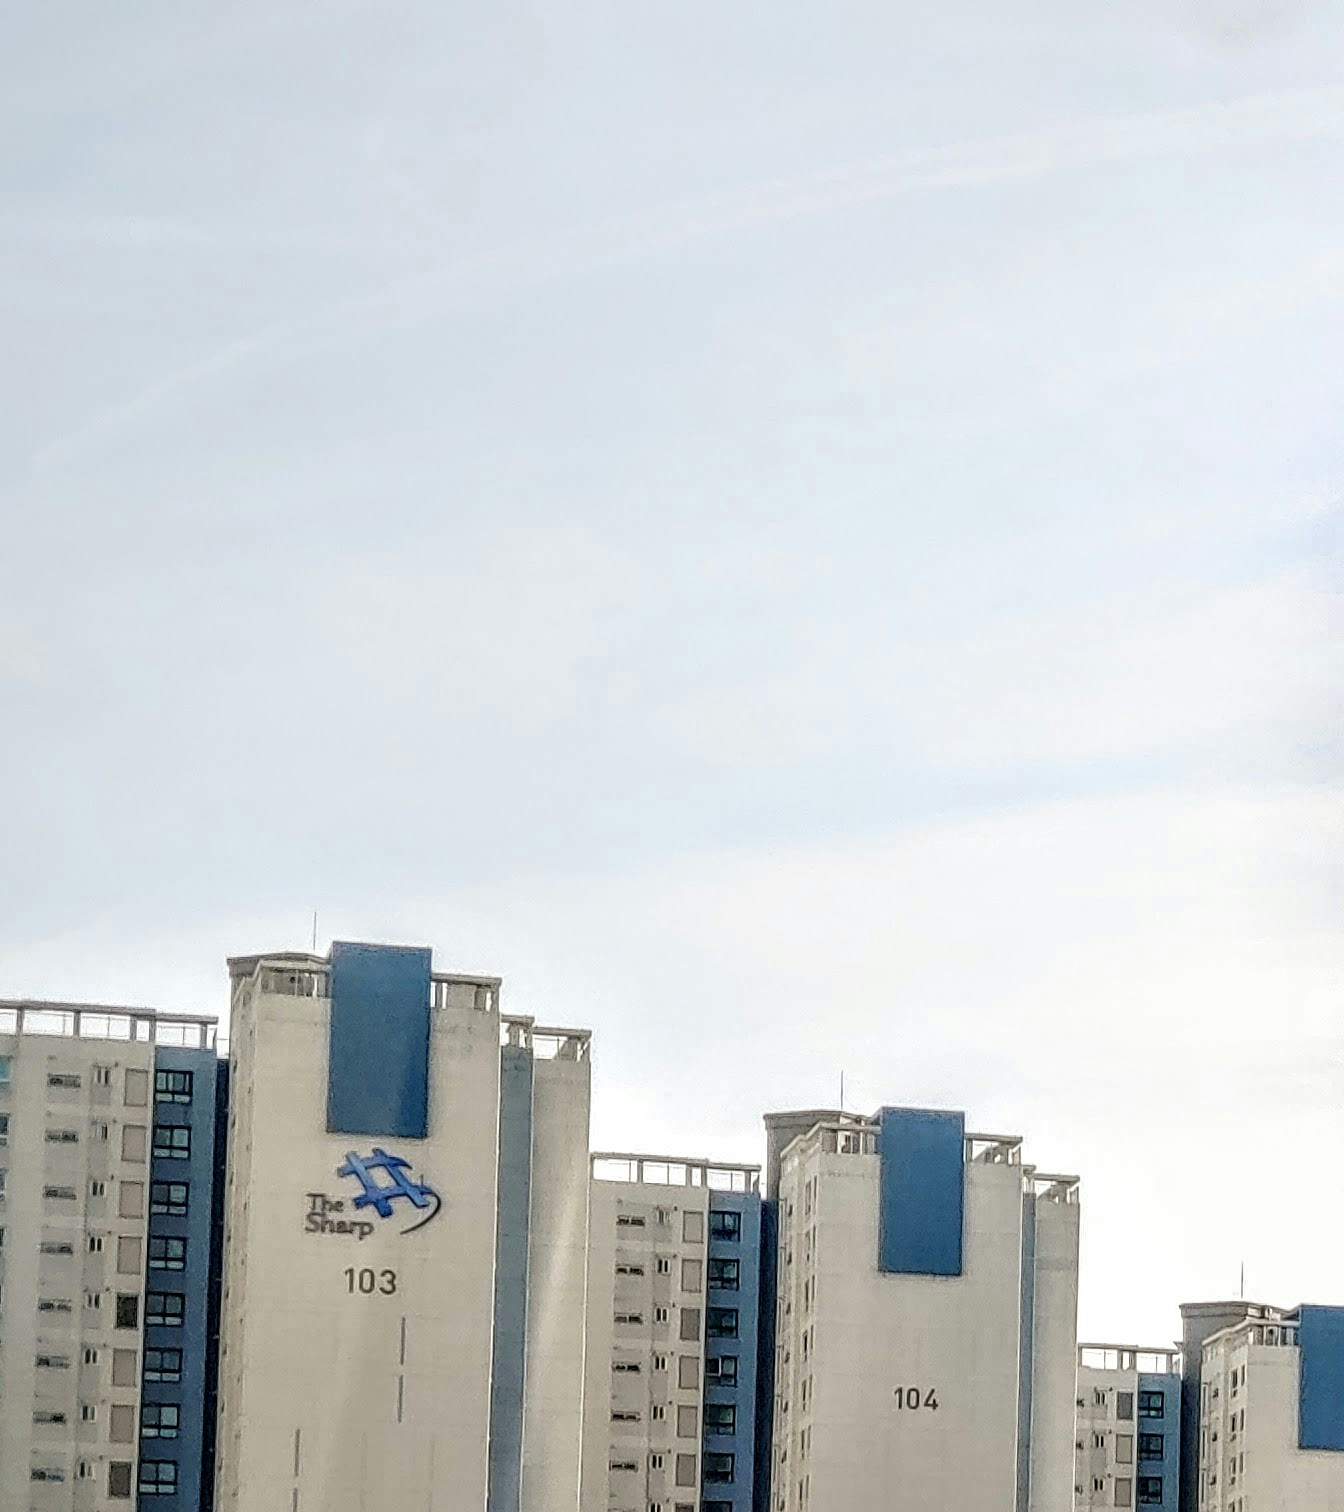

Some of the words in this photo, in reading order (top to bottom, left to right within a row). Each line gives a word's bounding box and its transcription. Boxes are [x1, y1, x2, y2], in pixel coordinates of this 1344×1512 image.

[306, 1193, 344, 1213] The
[305, 1212, 375, 1241] Sharp
[344, 1267, 397, 1295] 103
[894, 1386, 939, 1411] 104
